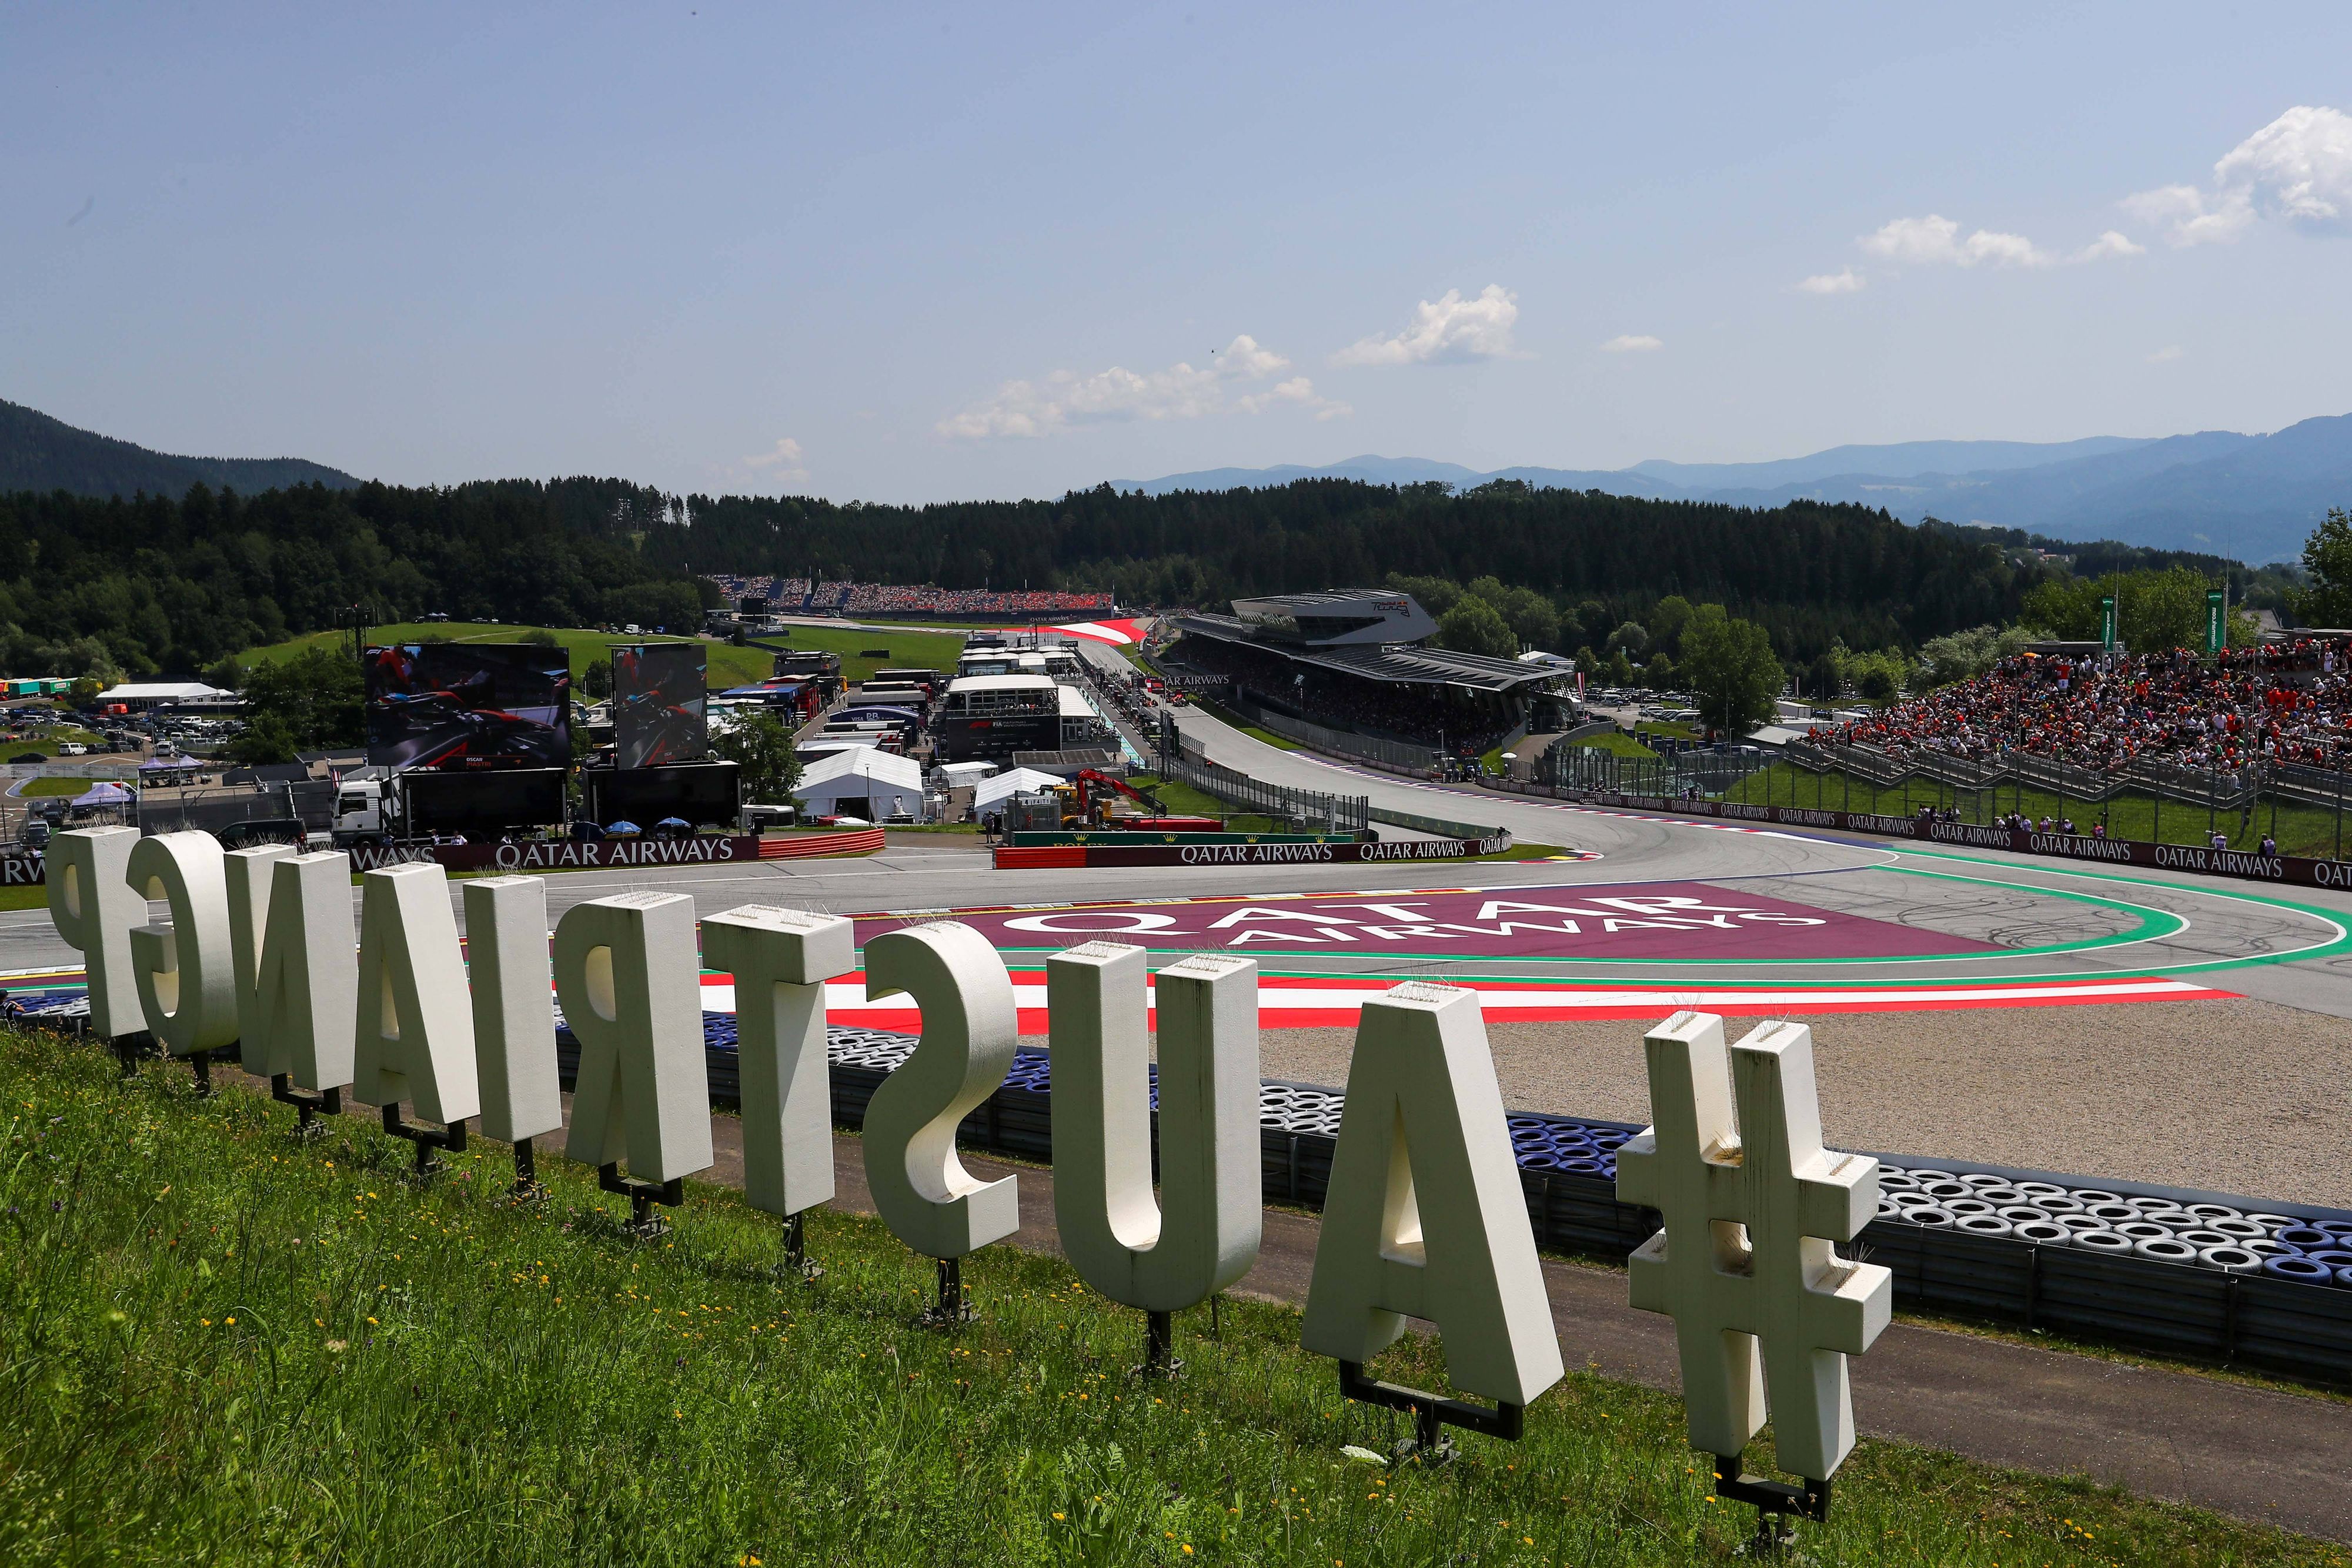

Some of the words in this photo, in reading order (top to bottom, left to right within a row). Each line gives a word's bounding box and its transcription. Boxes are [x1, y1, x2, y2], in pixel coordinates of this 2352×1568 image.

[1184, 675, 1230, 685] AIRWAYS
[1555, 788, 1568, 798] QATAR
[1604, 795, 1622, 805] AIRWAYS
[1628, 796, 1644, 807] QATAR
[1645, 798, 1664, 809] AIRWAYS
[1672, 800, 1689, 811] QATAR
[1689, 801, 1712, 814] AIRWAYS
[1720, 804, 1741, 817] QATAR
[1742, 806, 1769, 819] AIRWAYS
[1779, 808, 1803, 823] QATAR
[1804, 811, 1835, 825] AIRWAYS
[1848, 815, 1875, 830] QATAR
[1878, 817, 1915, 835] AIRWAYS
[1930, 823, 1963, 841] QATAR
[1966, 826, 2011, 847] AIRWAYS
[496, 842, 600, 867] QATAR
[609, 838, 733, 864] AIRWAYS
[1181, 846, 1247, 864] QATAR
[1252, 845, 1332, 861] AIRWAYS
[1361, 842, 1411, 861] QATAR
[1415, 841, 1465, 857] AIRWAYS
[1479, 837, 1500, 855] QATAR
[2030, 834, 2071, 853] QATAR
[2074, 838, 2131, 860] AIRWAYS
[2155, 846, 2206, 868] QATAR
[2211, 851, 2283, 878] AIRWAYS
[1003, 897, 1765, 936] QATAR
[1227, 912, 1827, 945] AIRWAYS
